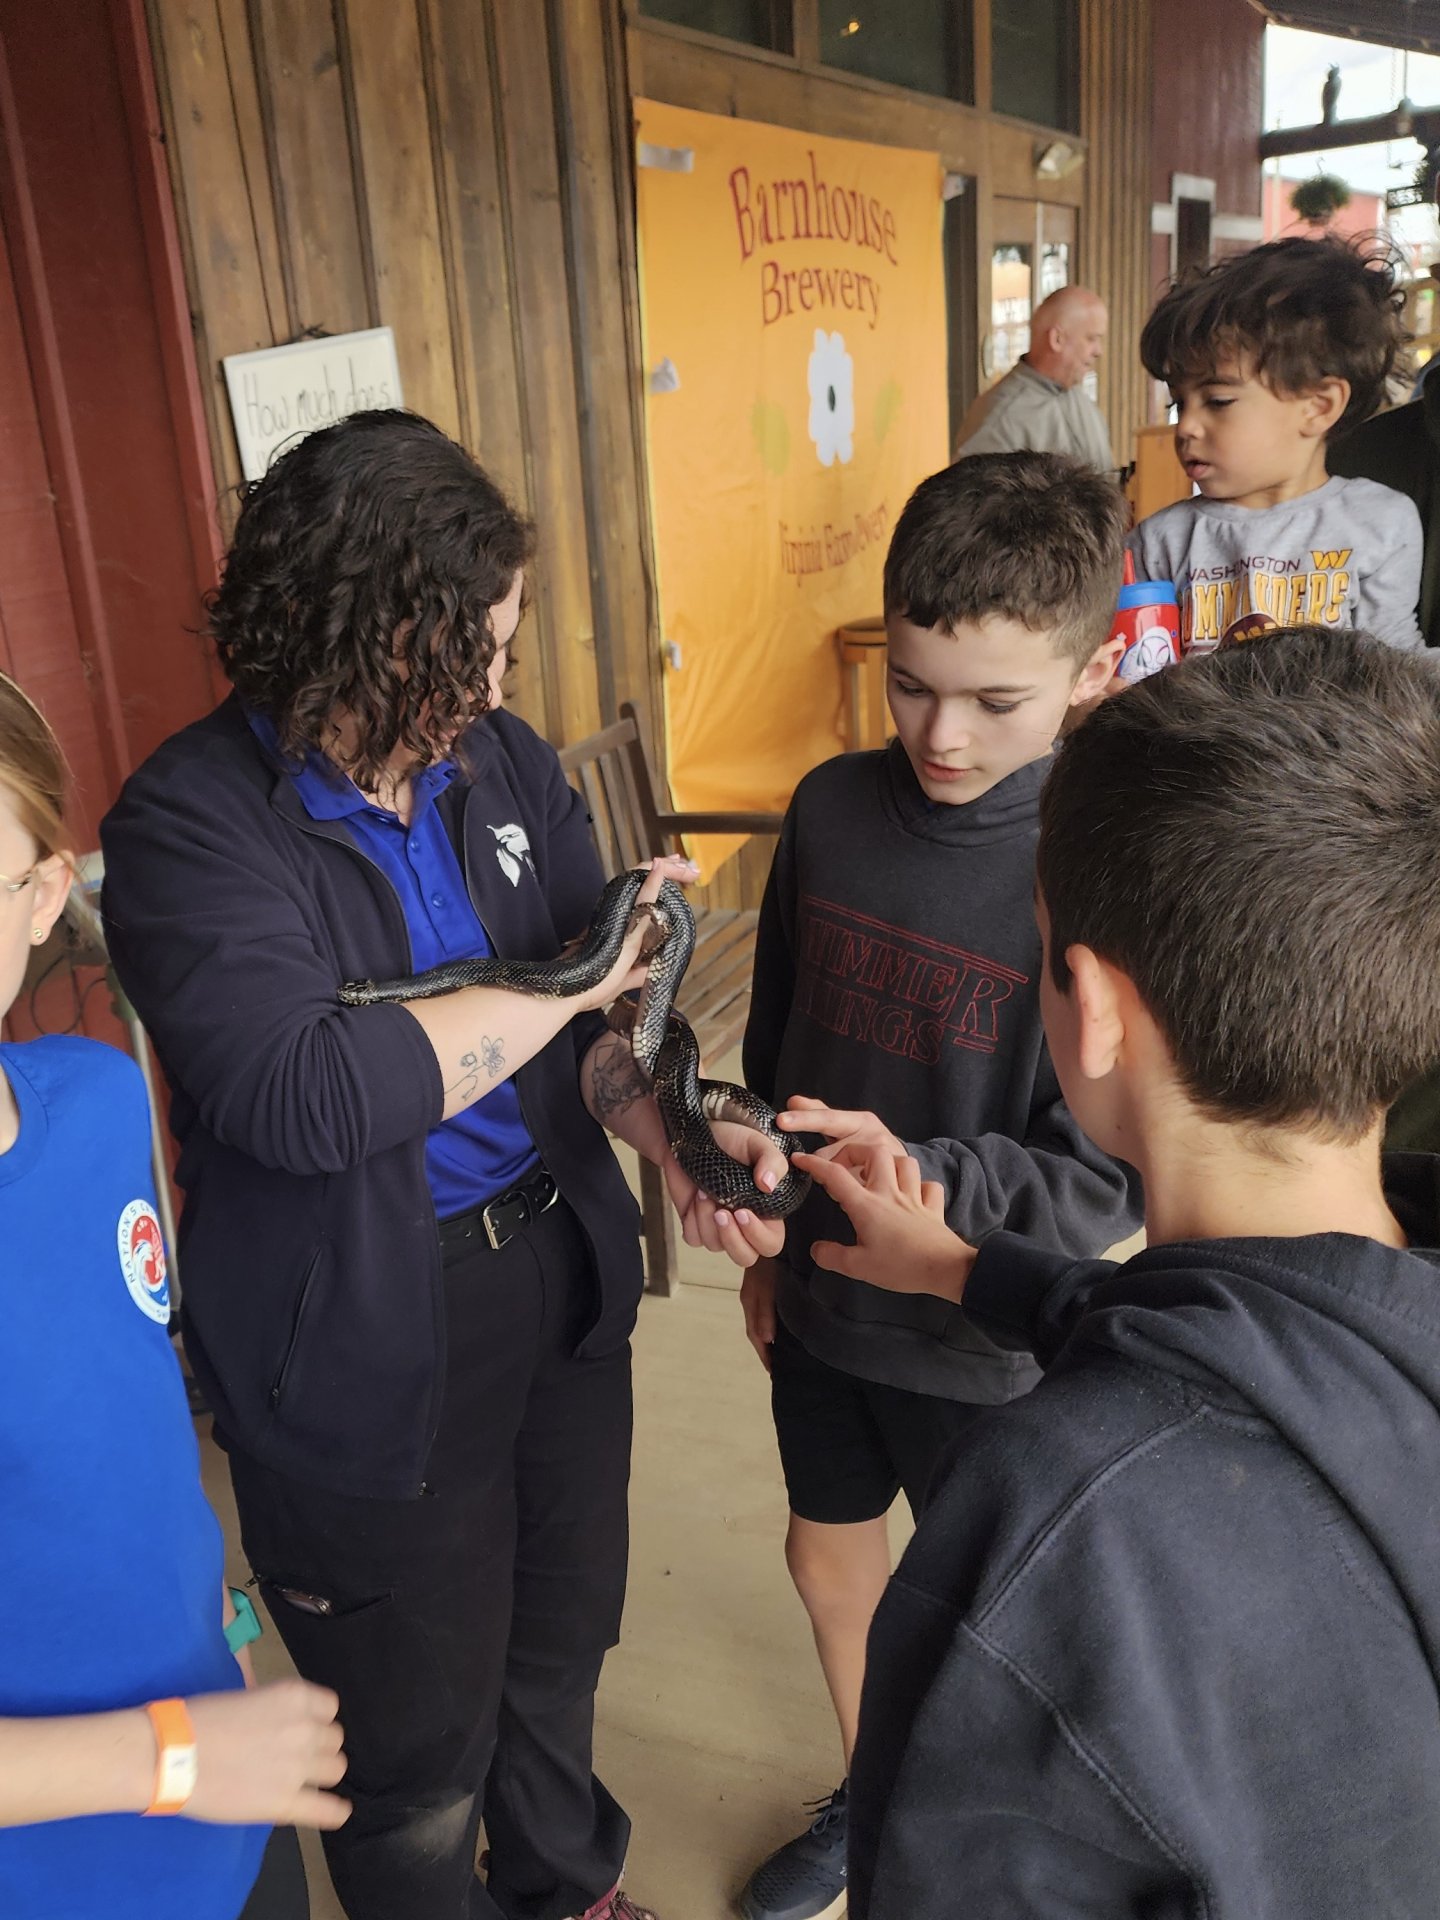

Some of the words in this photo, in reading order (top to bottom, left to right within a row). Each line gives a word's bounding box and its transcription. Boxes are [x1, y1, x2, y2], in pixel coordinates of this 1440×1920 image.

[728, 150, 898, 266] Barnhouse
[761, 260, 881, 330] Brewery
[242, 371, 291, 438] How
[297, 362, 338, 425] much
